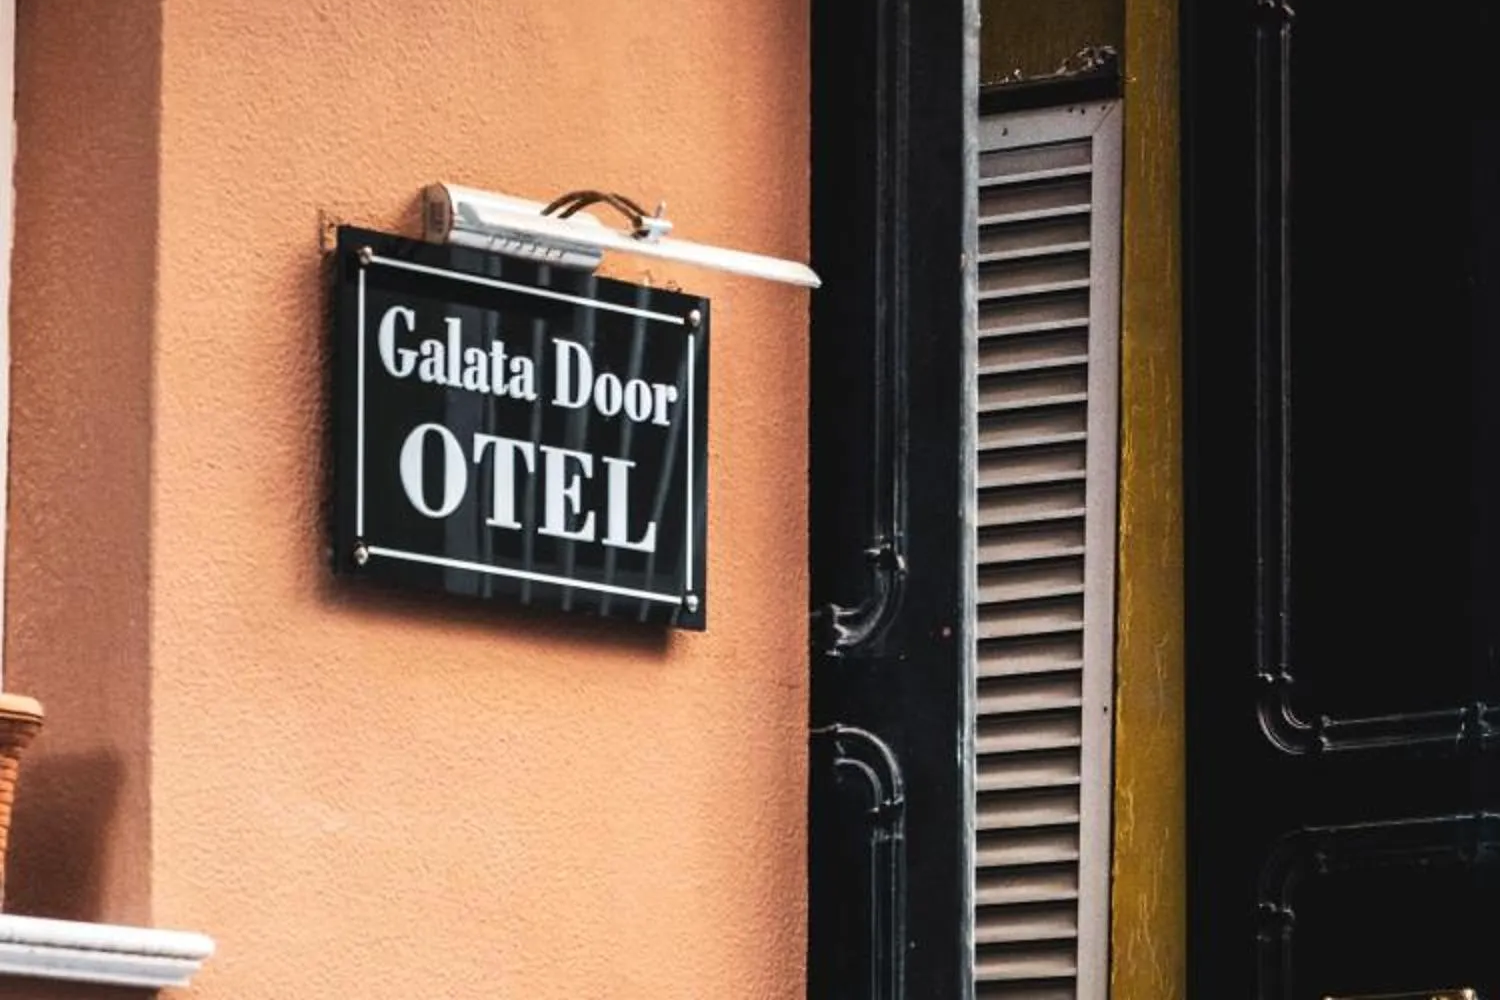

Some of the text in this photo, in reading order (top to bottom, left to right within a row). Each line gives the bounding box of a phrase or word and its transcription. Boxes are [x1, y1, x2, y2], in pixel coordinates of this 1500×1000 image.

[378, 305, 679, 426] Galata Door
[399, 423, 657, 553] OTEL
